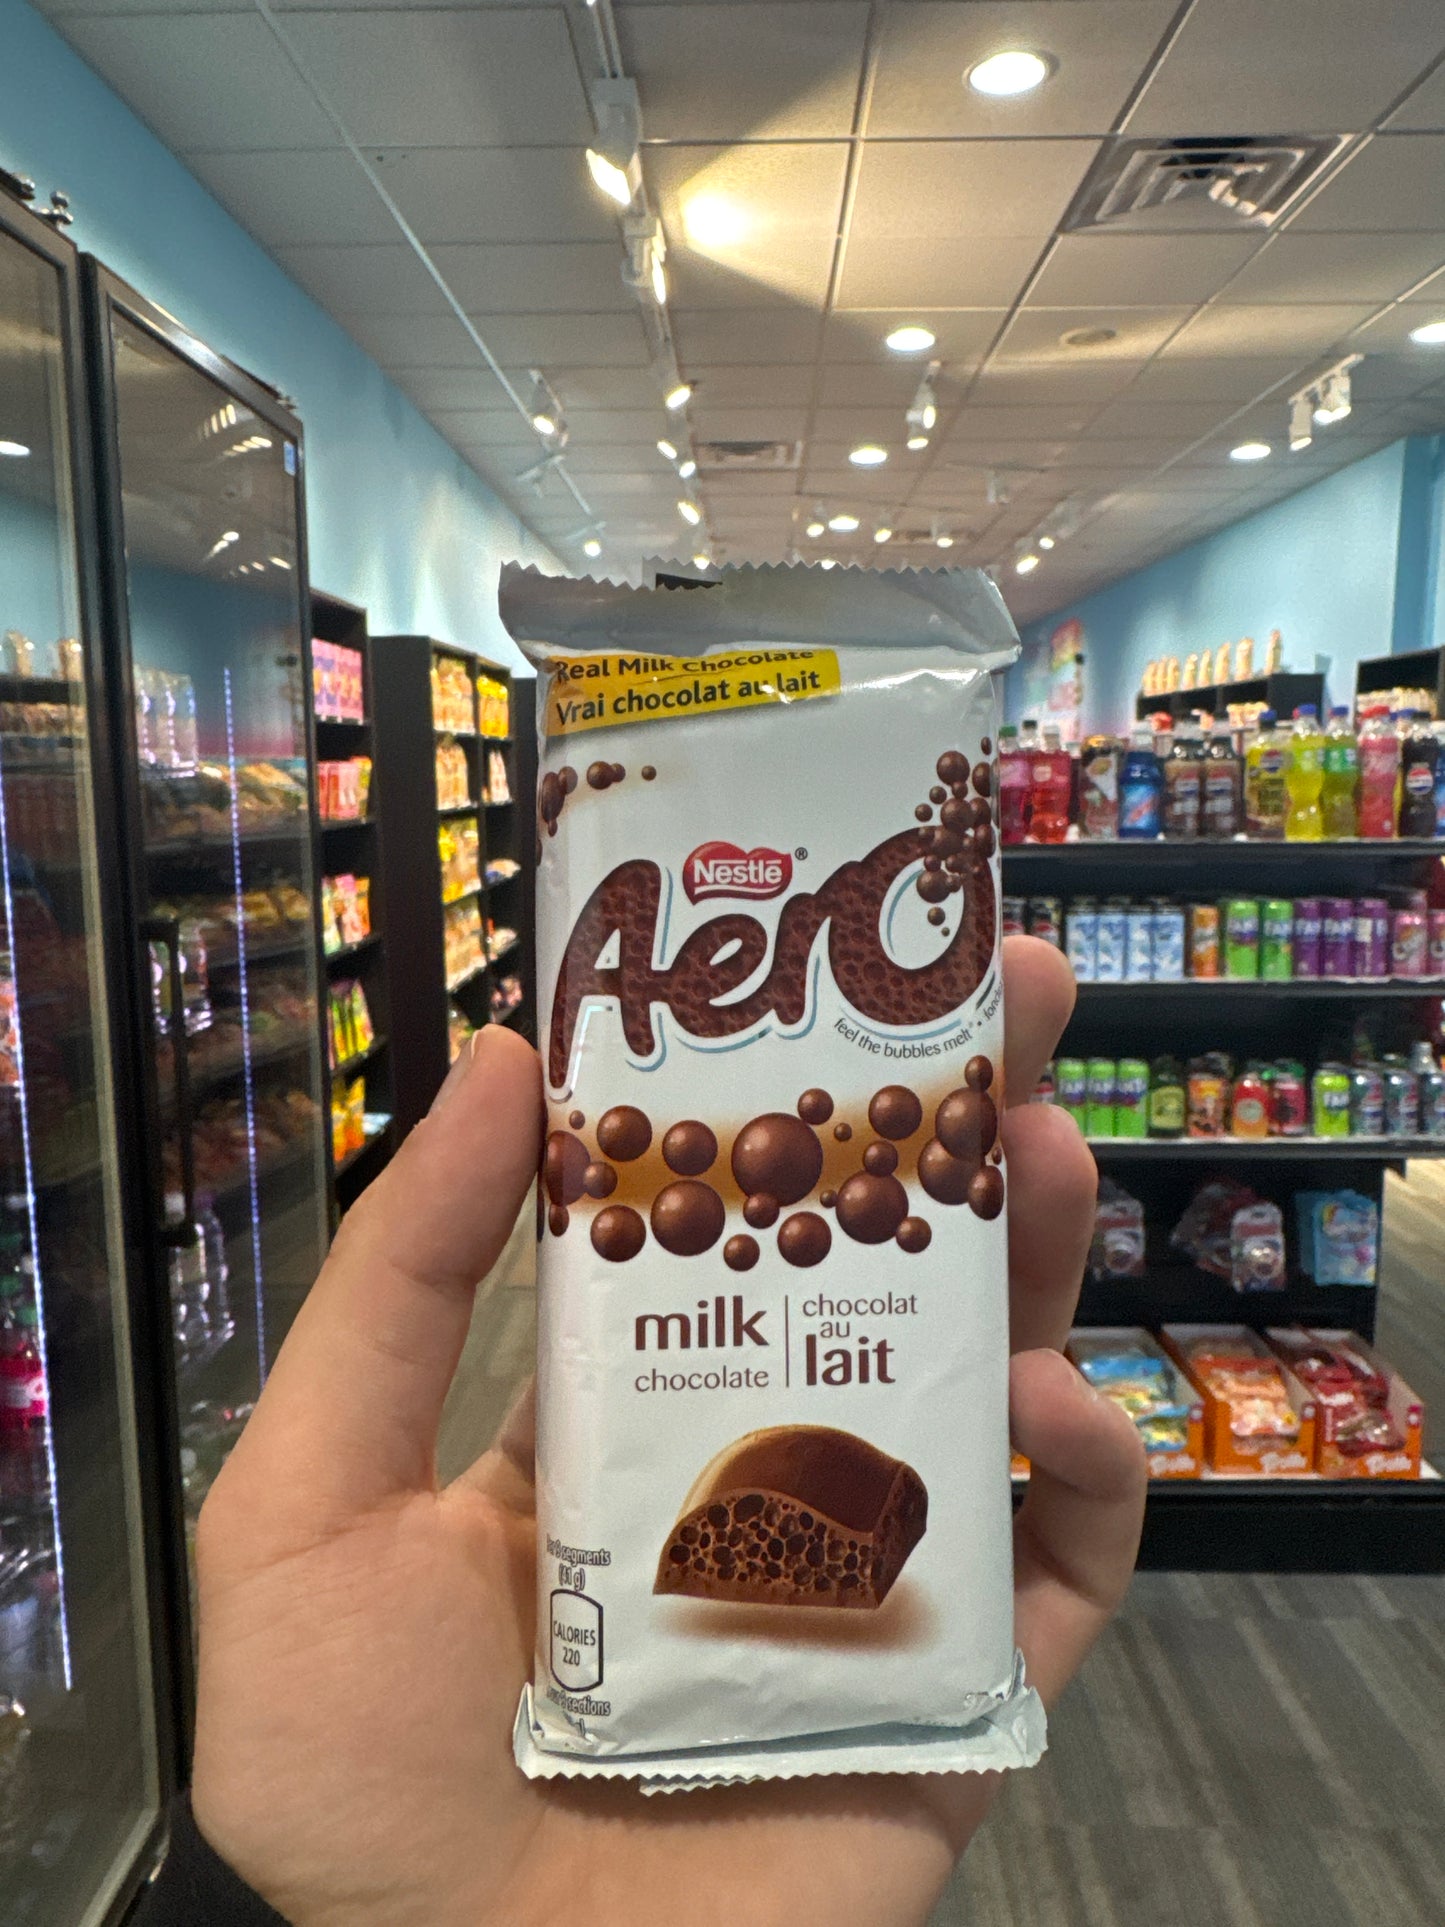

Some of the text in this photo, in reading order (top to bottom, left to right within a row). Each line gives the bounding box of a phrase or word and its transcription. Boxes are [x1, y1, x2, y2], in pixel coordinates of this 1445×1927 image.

[556, 649, 815, 683] Real Milk Chocolate
[556, 670, 821, 726] Vrai chocolat au lait
[548, 825, 996, 1090] Aero
[834, 1018, 858, 1043] feel
[858, 1035, 881, 1055] the
[884, 1043, 941, 1059] bubbles
[802, 1291, 919, 1317] chocolat
[634, 1295, 770, 1351] milk
[819, 1320, 850, 1339] au
[805, 1333, 896, 1386] lait
[634, 1365, 770, 1392] chocolate
[561, 1545, 611, 1567] segments
[553, 1620, 596, 1646] CALORIES
[562, 1646, 580, 1667] 220
[566, 1695, 611, 1717] sections
